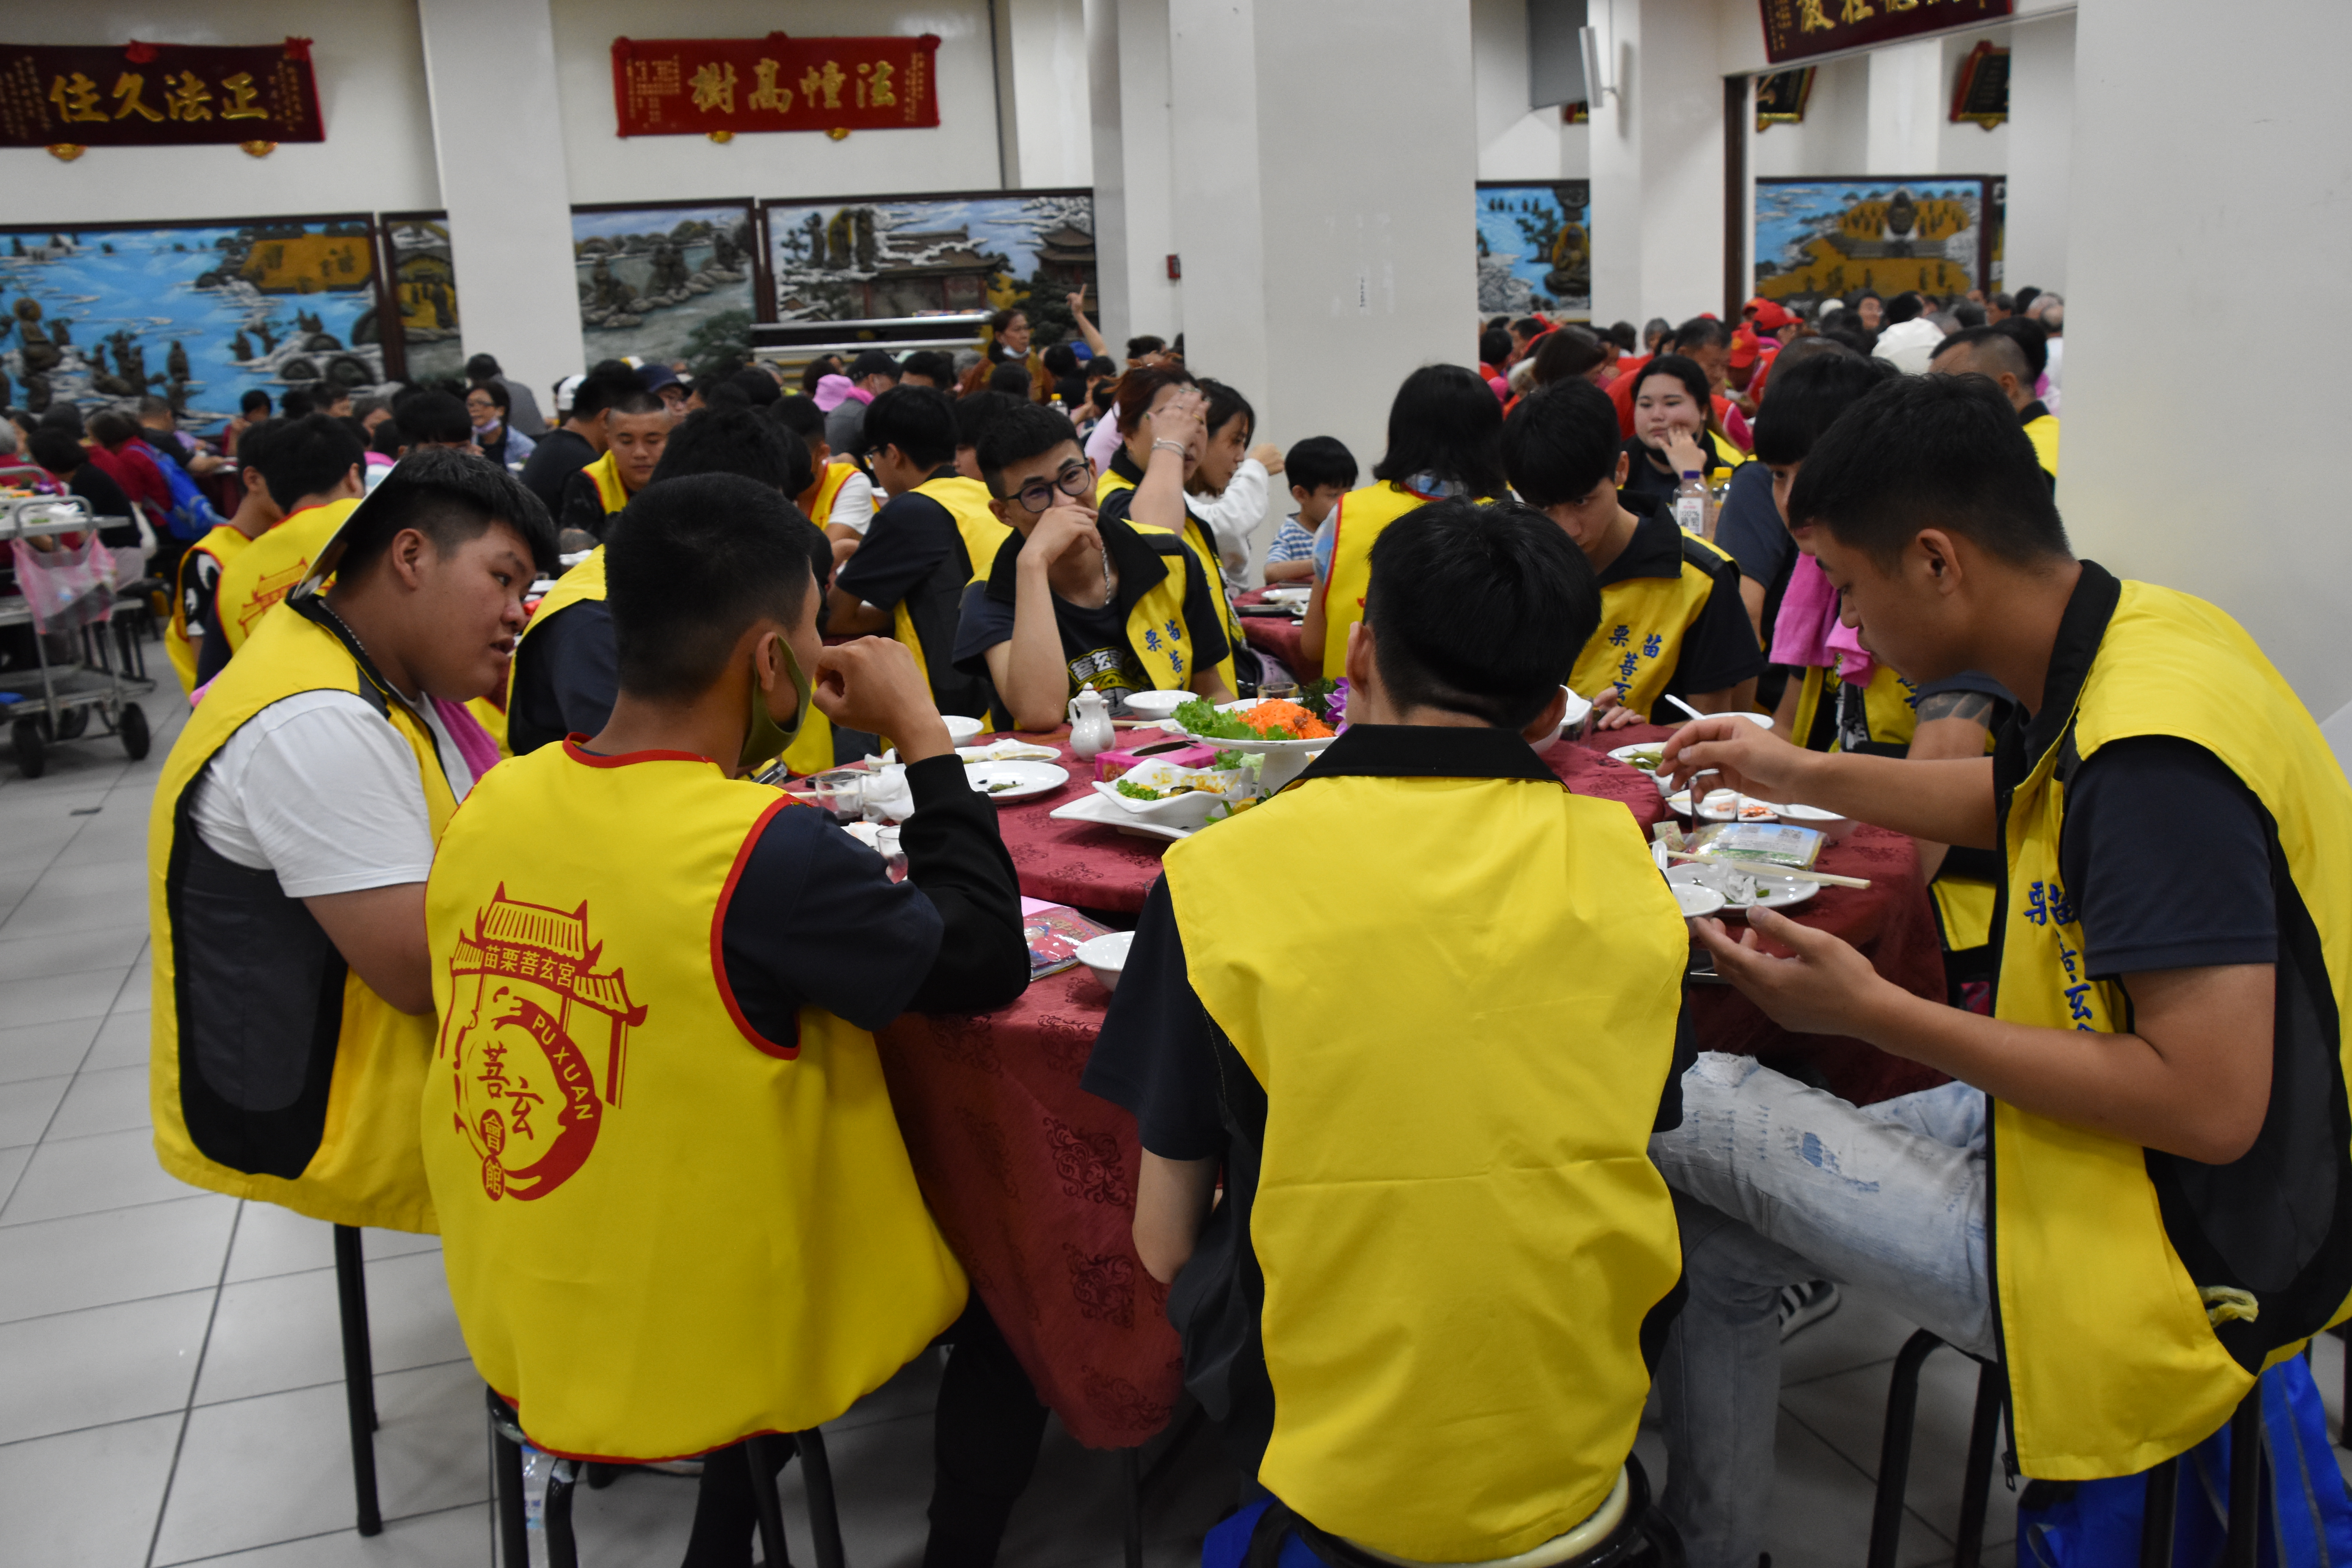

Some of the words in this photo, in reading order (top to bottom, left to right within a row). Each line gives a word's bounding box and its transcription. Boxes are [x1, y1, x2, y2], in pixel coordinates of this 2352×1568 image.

[484, 944, 575, 988] 苗栗菩玄宮
[532, 1013, 557, 1045] PU
[552, 1046, 594, 1120] XUAN
